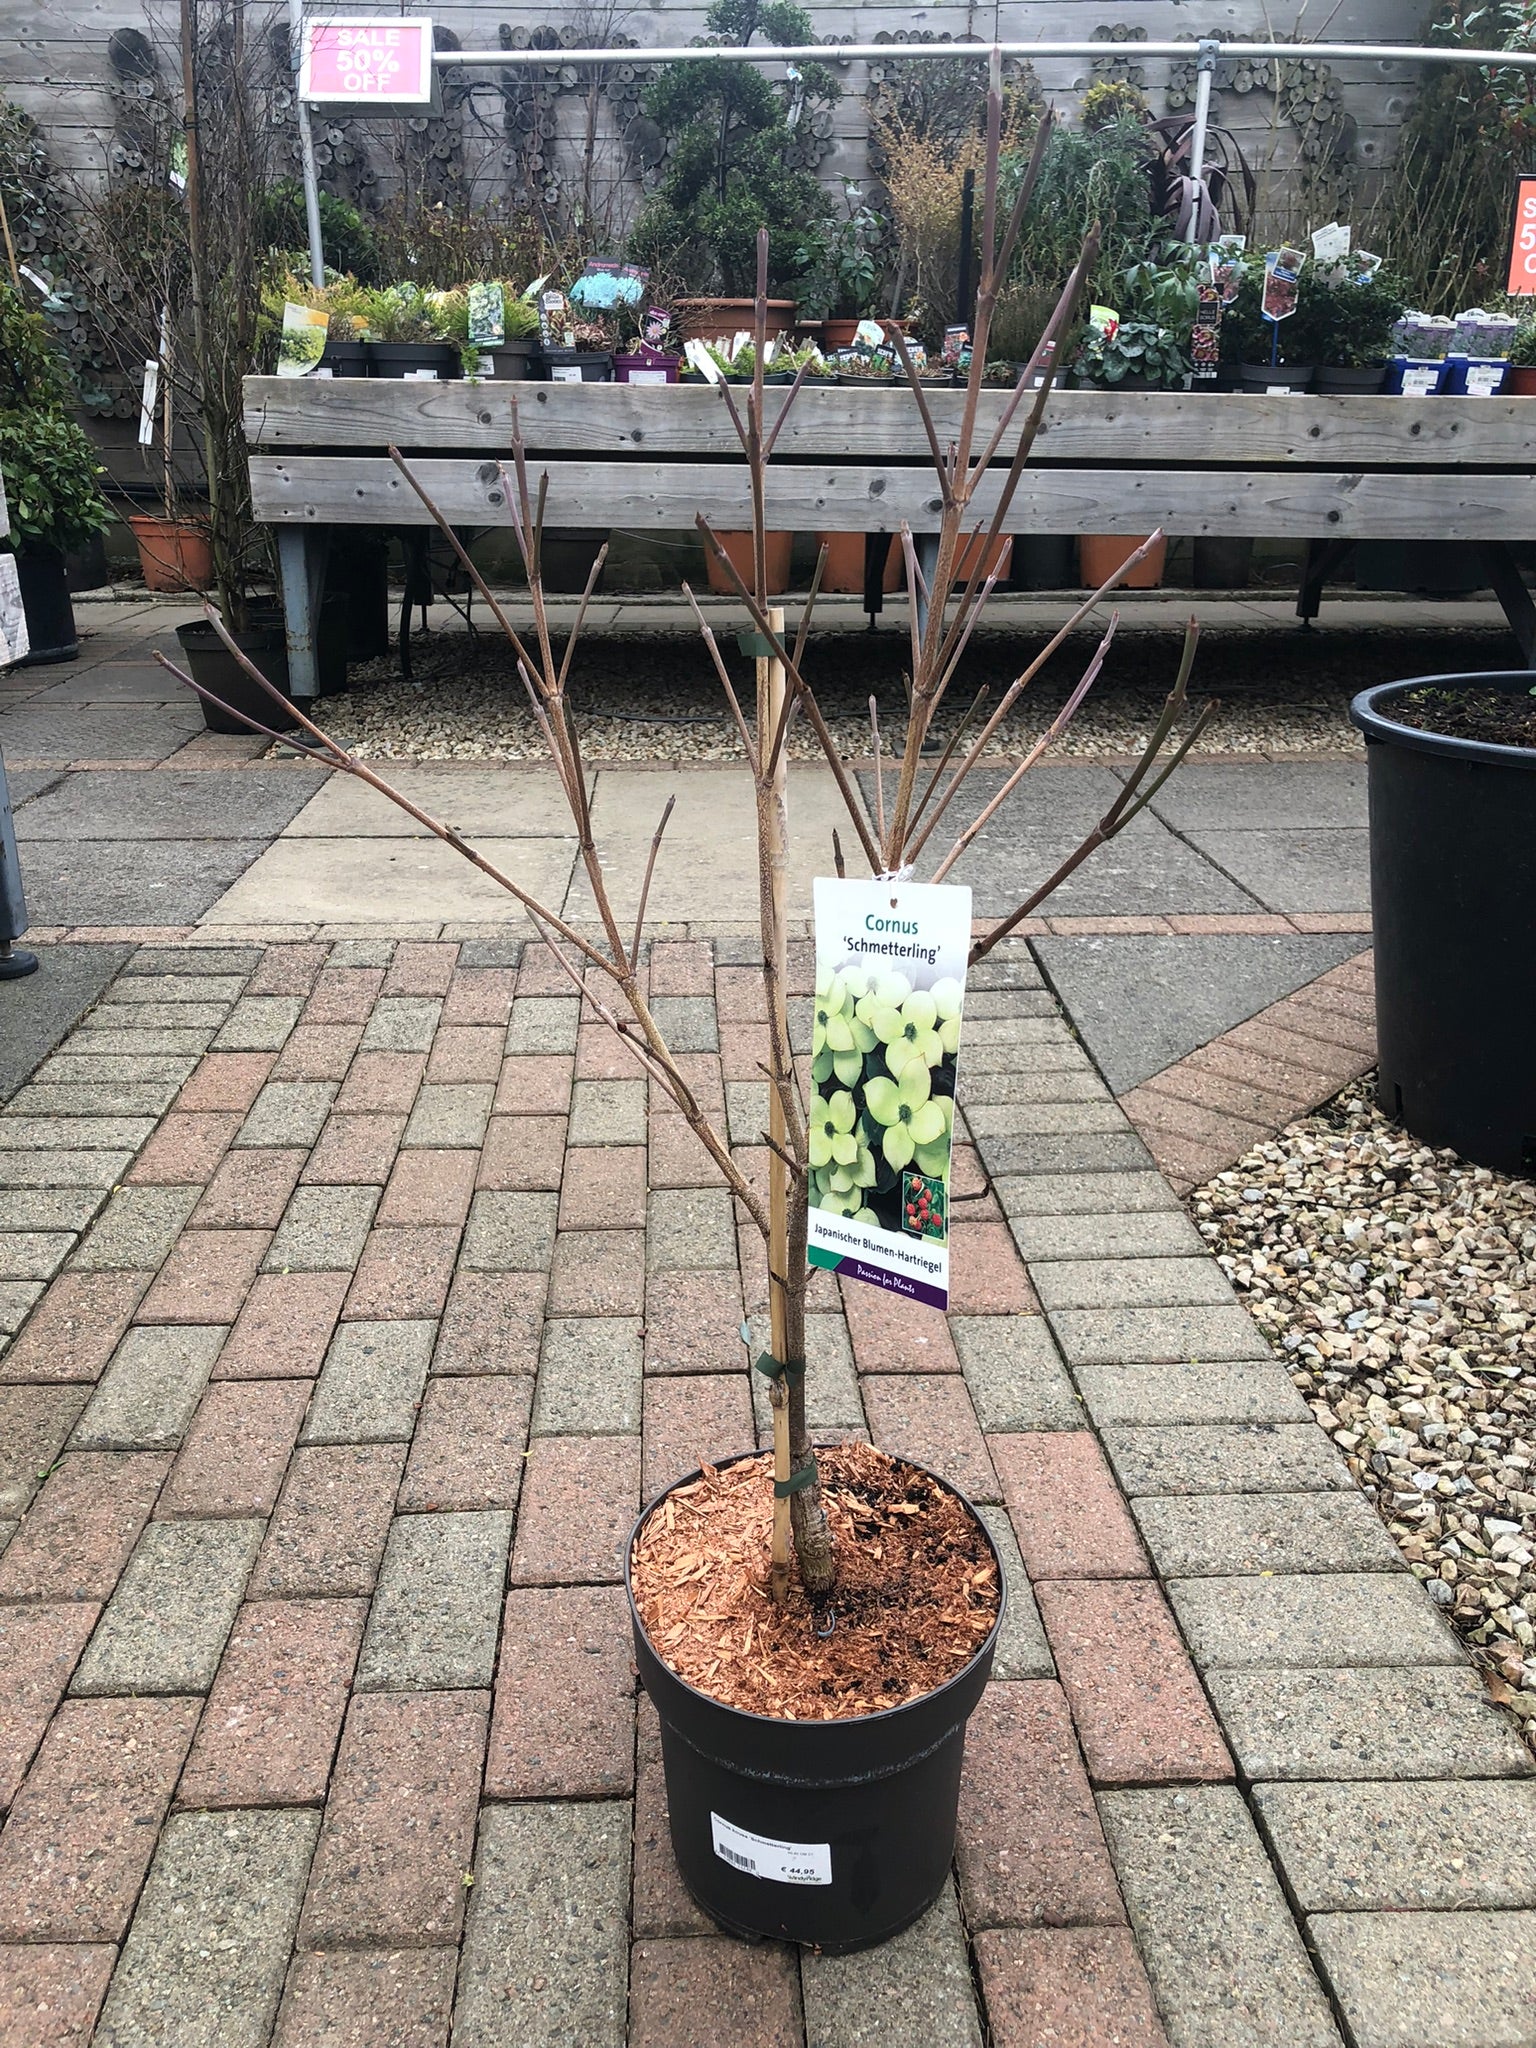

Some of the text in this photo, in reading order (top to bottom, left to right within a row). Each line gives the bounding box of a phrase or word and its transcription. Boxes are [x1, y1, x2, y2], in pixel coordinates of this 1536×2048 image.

[337, 28, 401, 47] SALE
[335, 49, 400, 73] 50%
[343, 73, 392, 92] OFF
[865, 914, 919, 935] Cornus
[843, 936, 941, 965] 'Schmetterling'
[814, 1223, 943, 1274] Japanischer Blumen-Hartriegel
[857, 1264, 882, 1281] Passion
[882, 1272, 893, 1286] for
